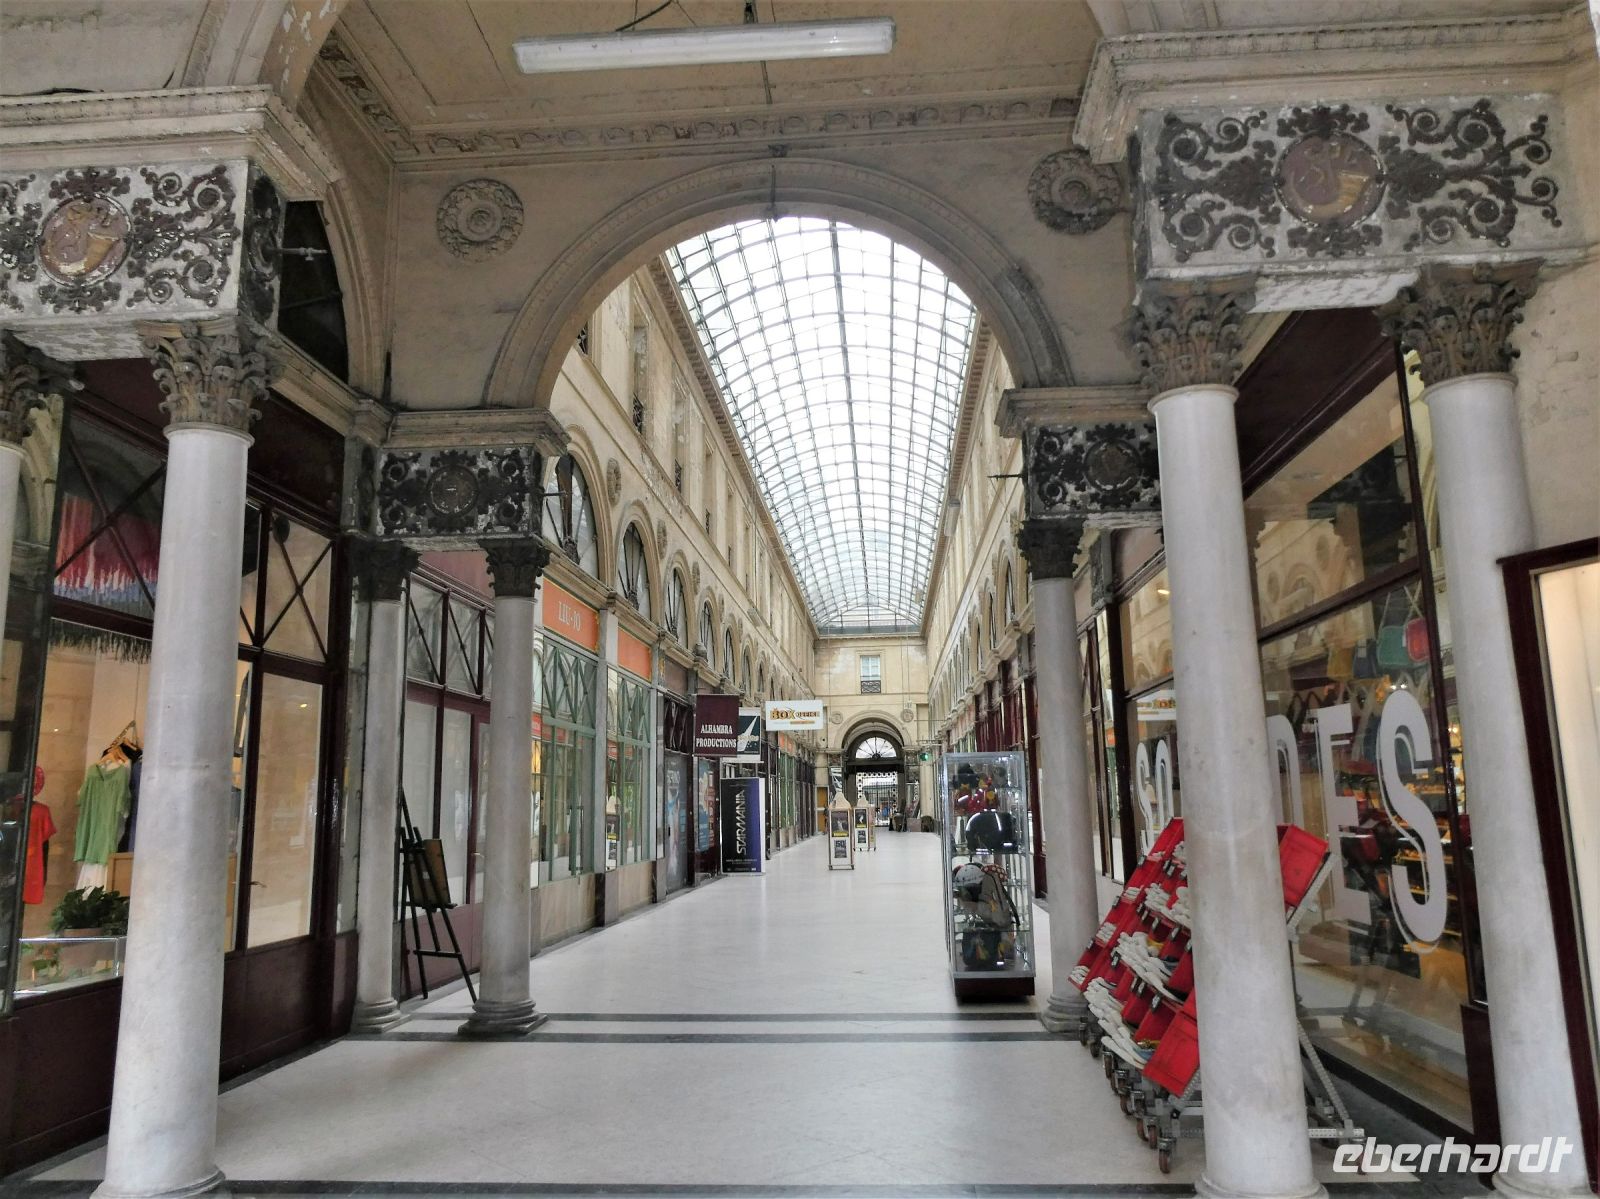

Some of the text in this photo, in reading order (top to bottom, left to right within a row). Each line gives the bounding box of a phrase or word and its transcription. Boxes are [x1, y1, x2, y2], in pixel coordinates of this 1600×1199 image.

[771, 708, 795, 719] BOX
[700, 724, 733, 735] ALHAMBRA
[695, 738, 737, 748] PRODUCTIONS
[735, 789, 747, 856] STARMANIA
